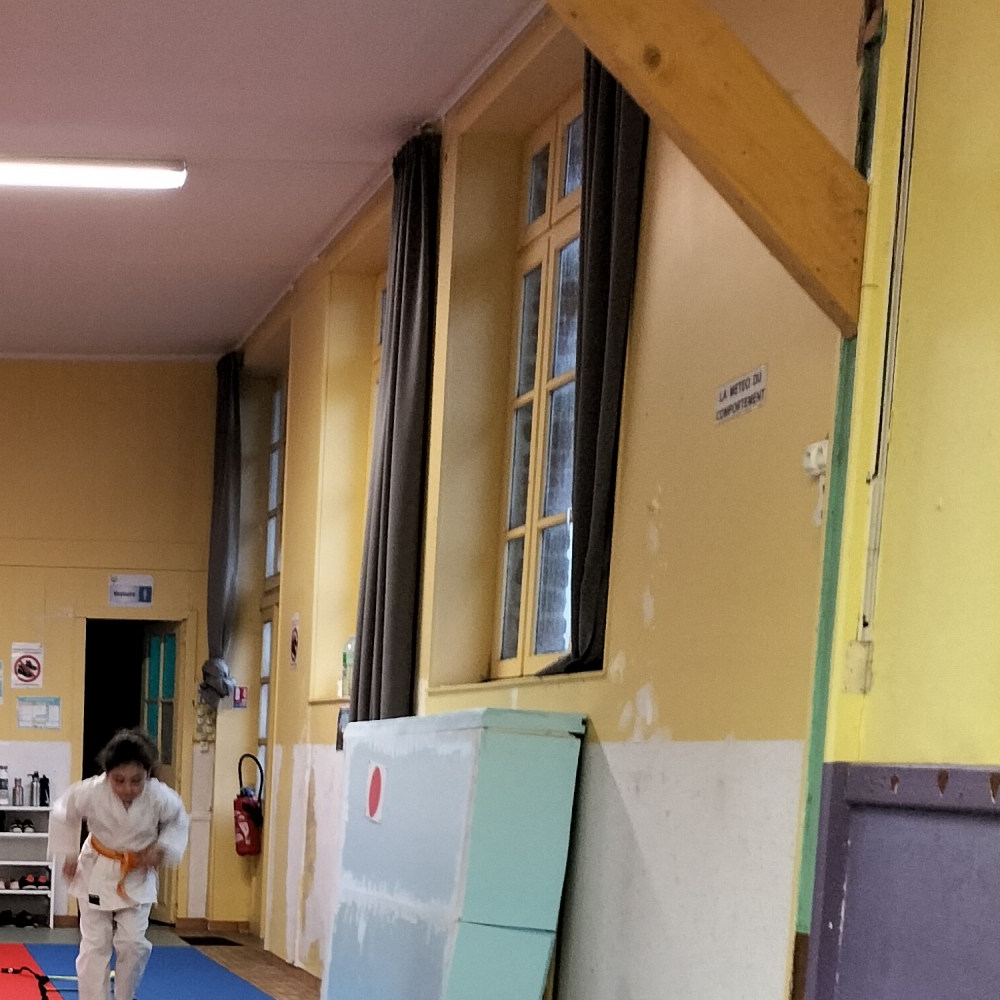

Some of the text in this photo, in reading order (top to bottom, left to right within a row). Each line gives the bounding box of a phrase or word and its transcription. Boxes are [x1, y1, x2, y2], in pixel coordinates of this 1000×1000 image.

[719, 388, 727, 402] LA
[753, 371, 762, 386] DU
[716, 387, 765, 421] COMPORTEMENT
